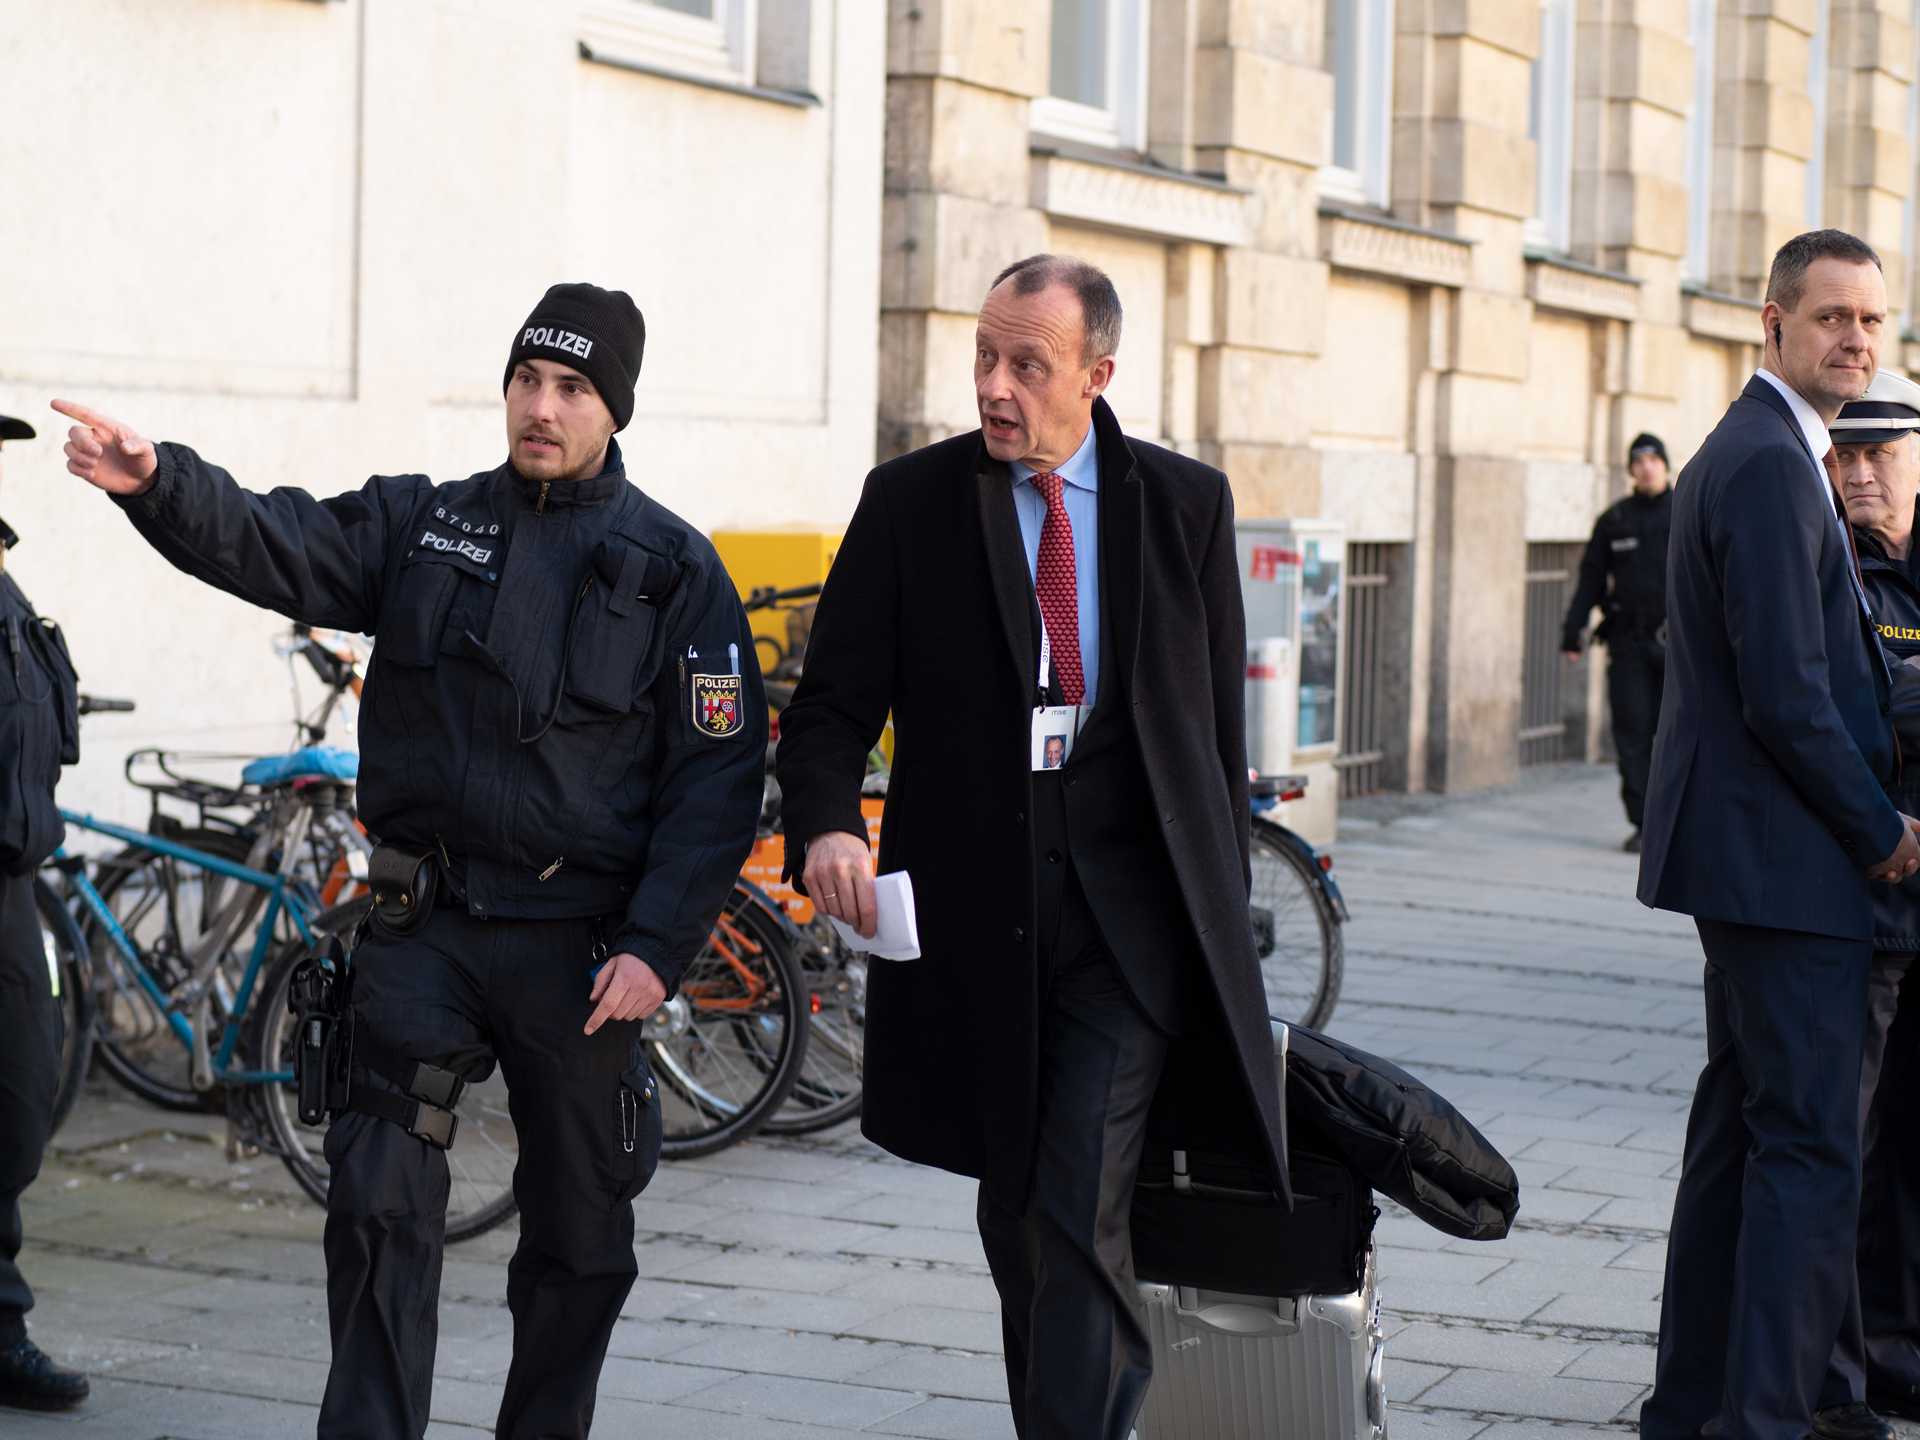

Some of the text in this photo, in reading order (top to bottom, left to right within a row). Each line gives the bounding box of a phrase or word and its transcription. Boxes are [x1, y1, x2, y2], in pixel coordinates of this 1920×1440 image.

[521, 327, 594, 360] POLIZEI
[435, 507, 500, 535] 87040
[420, 531, 493, 564] POLIZEI
[696, 678, 739, 689] POLIZEI
